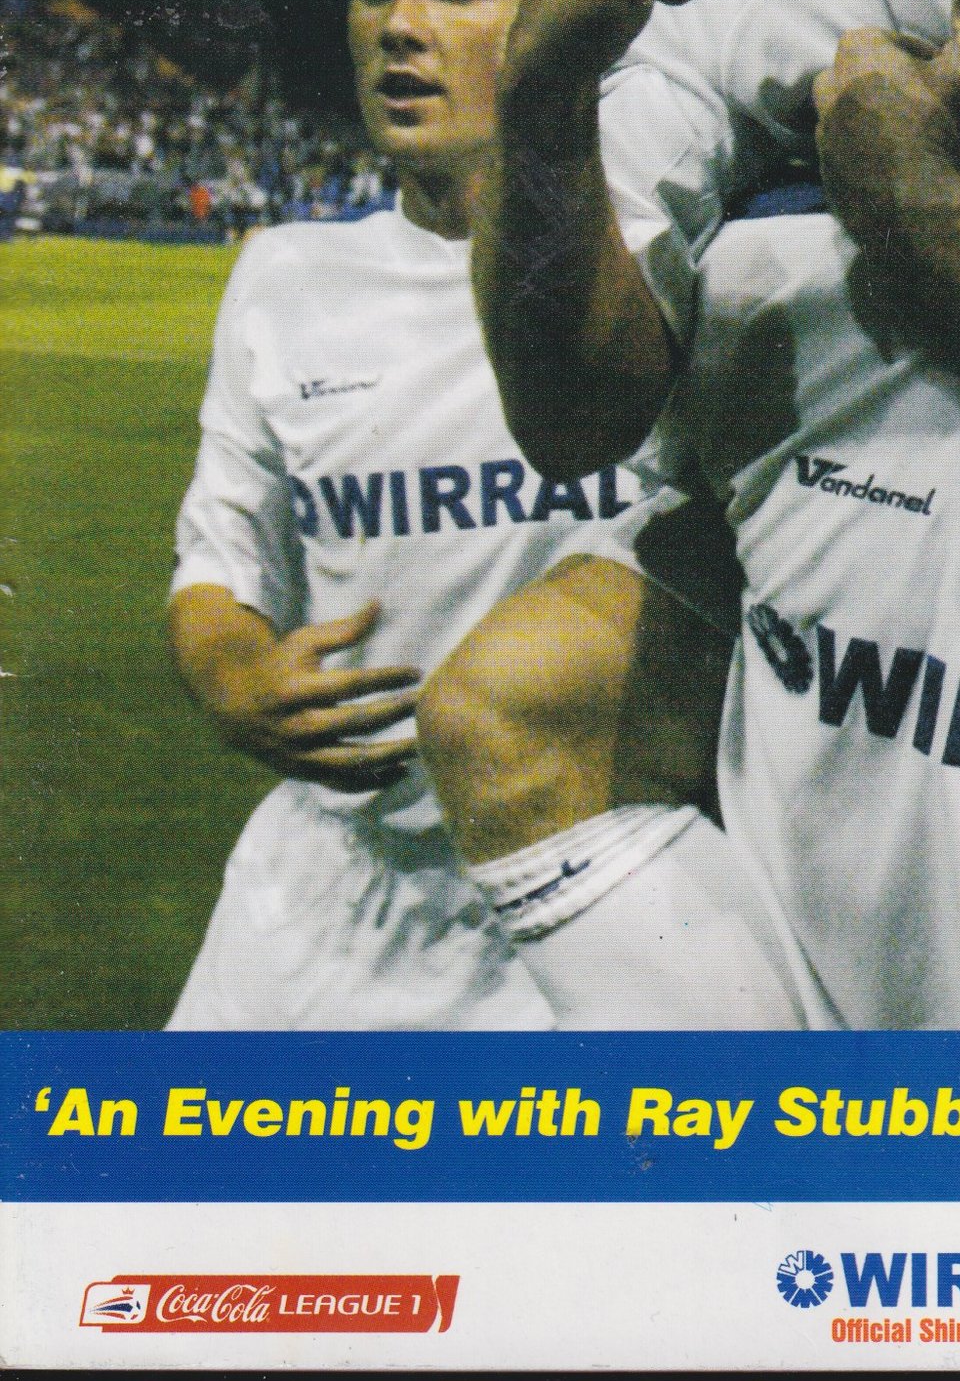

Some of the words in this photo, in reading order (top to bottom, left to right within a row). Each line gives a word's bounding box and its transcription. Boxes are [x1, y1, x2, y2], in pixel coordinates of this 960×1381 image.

[319, 458, 634, 538] WIRRAL
[794, 454, 937, 517] Vandanel
[164, 1087, 434, 1150] Evening
[459, 1088, 600, 1136] with
[627, 1088, 753, 1149] Ray
[156, 1283, 277, 1323] Coca-Cola
[279, 1295, 401, 1315] LEAGUE
[412, 1295, 421, 1314] 1
[831, 1317, 912, 1343] Official
